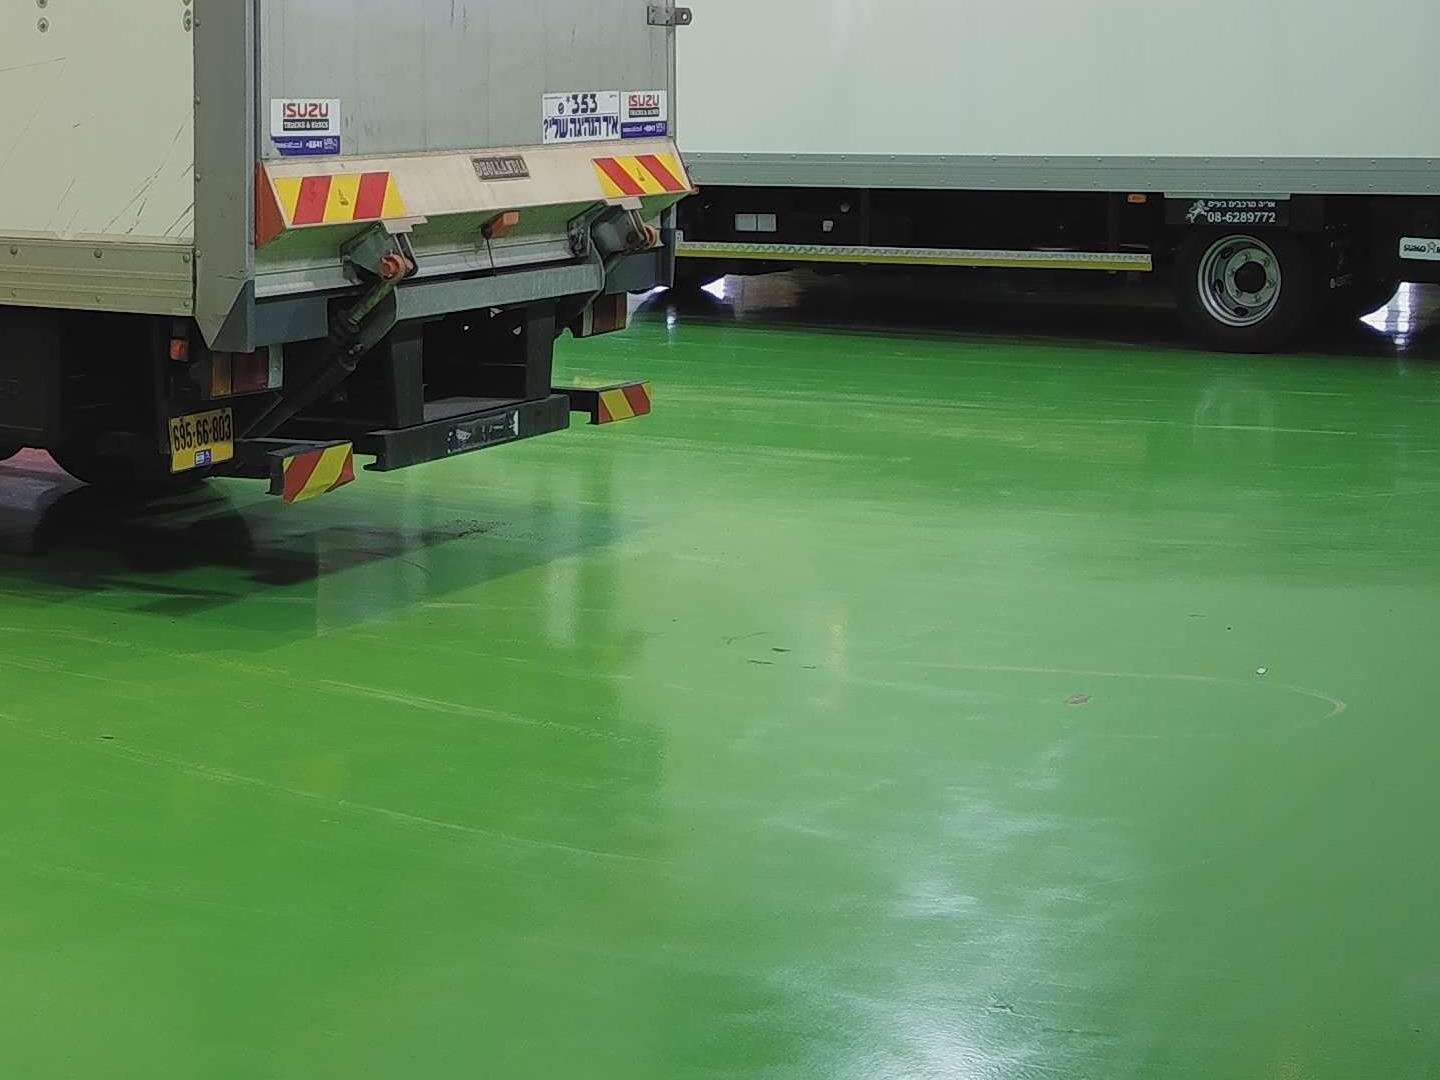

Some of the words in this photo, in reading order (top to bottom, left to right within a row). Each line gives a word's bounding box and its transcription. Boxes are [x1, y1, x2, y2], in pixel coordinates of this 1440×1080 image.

[628, 94, 660, 107] ISUZU
[282, 103, 329, 118] ISUZU
[1207, 211, 1276, 223] 08-6289772
